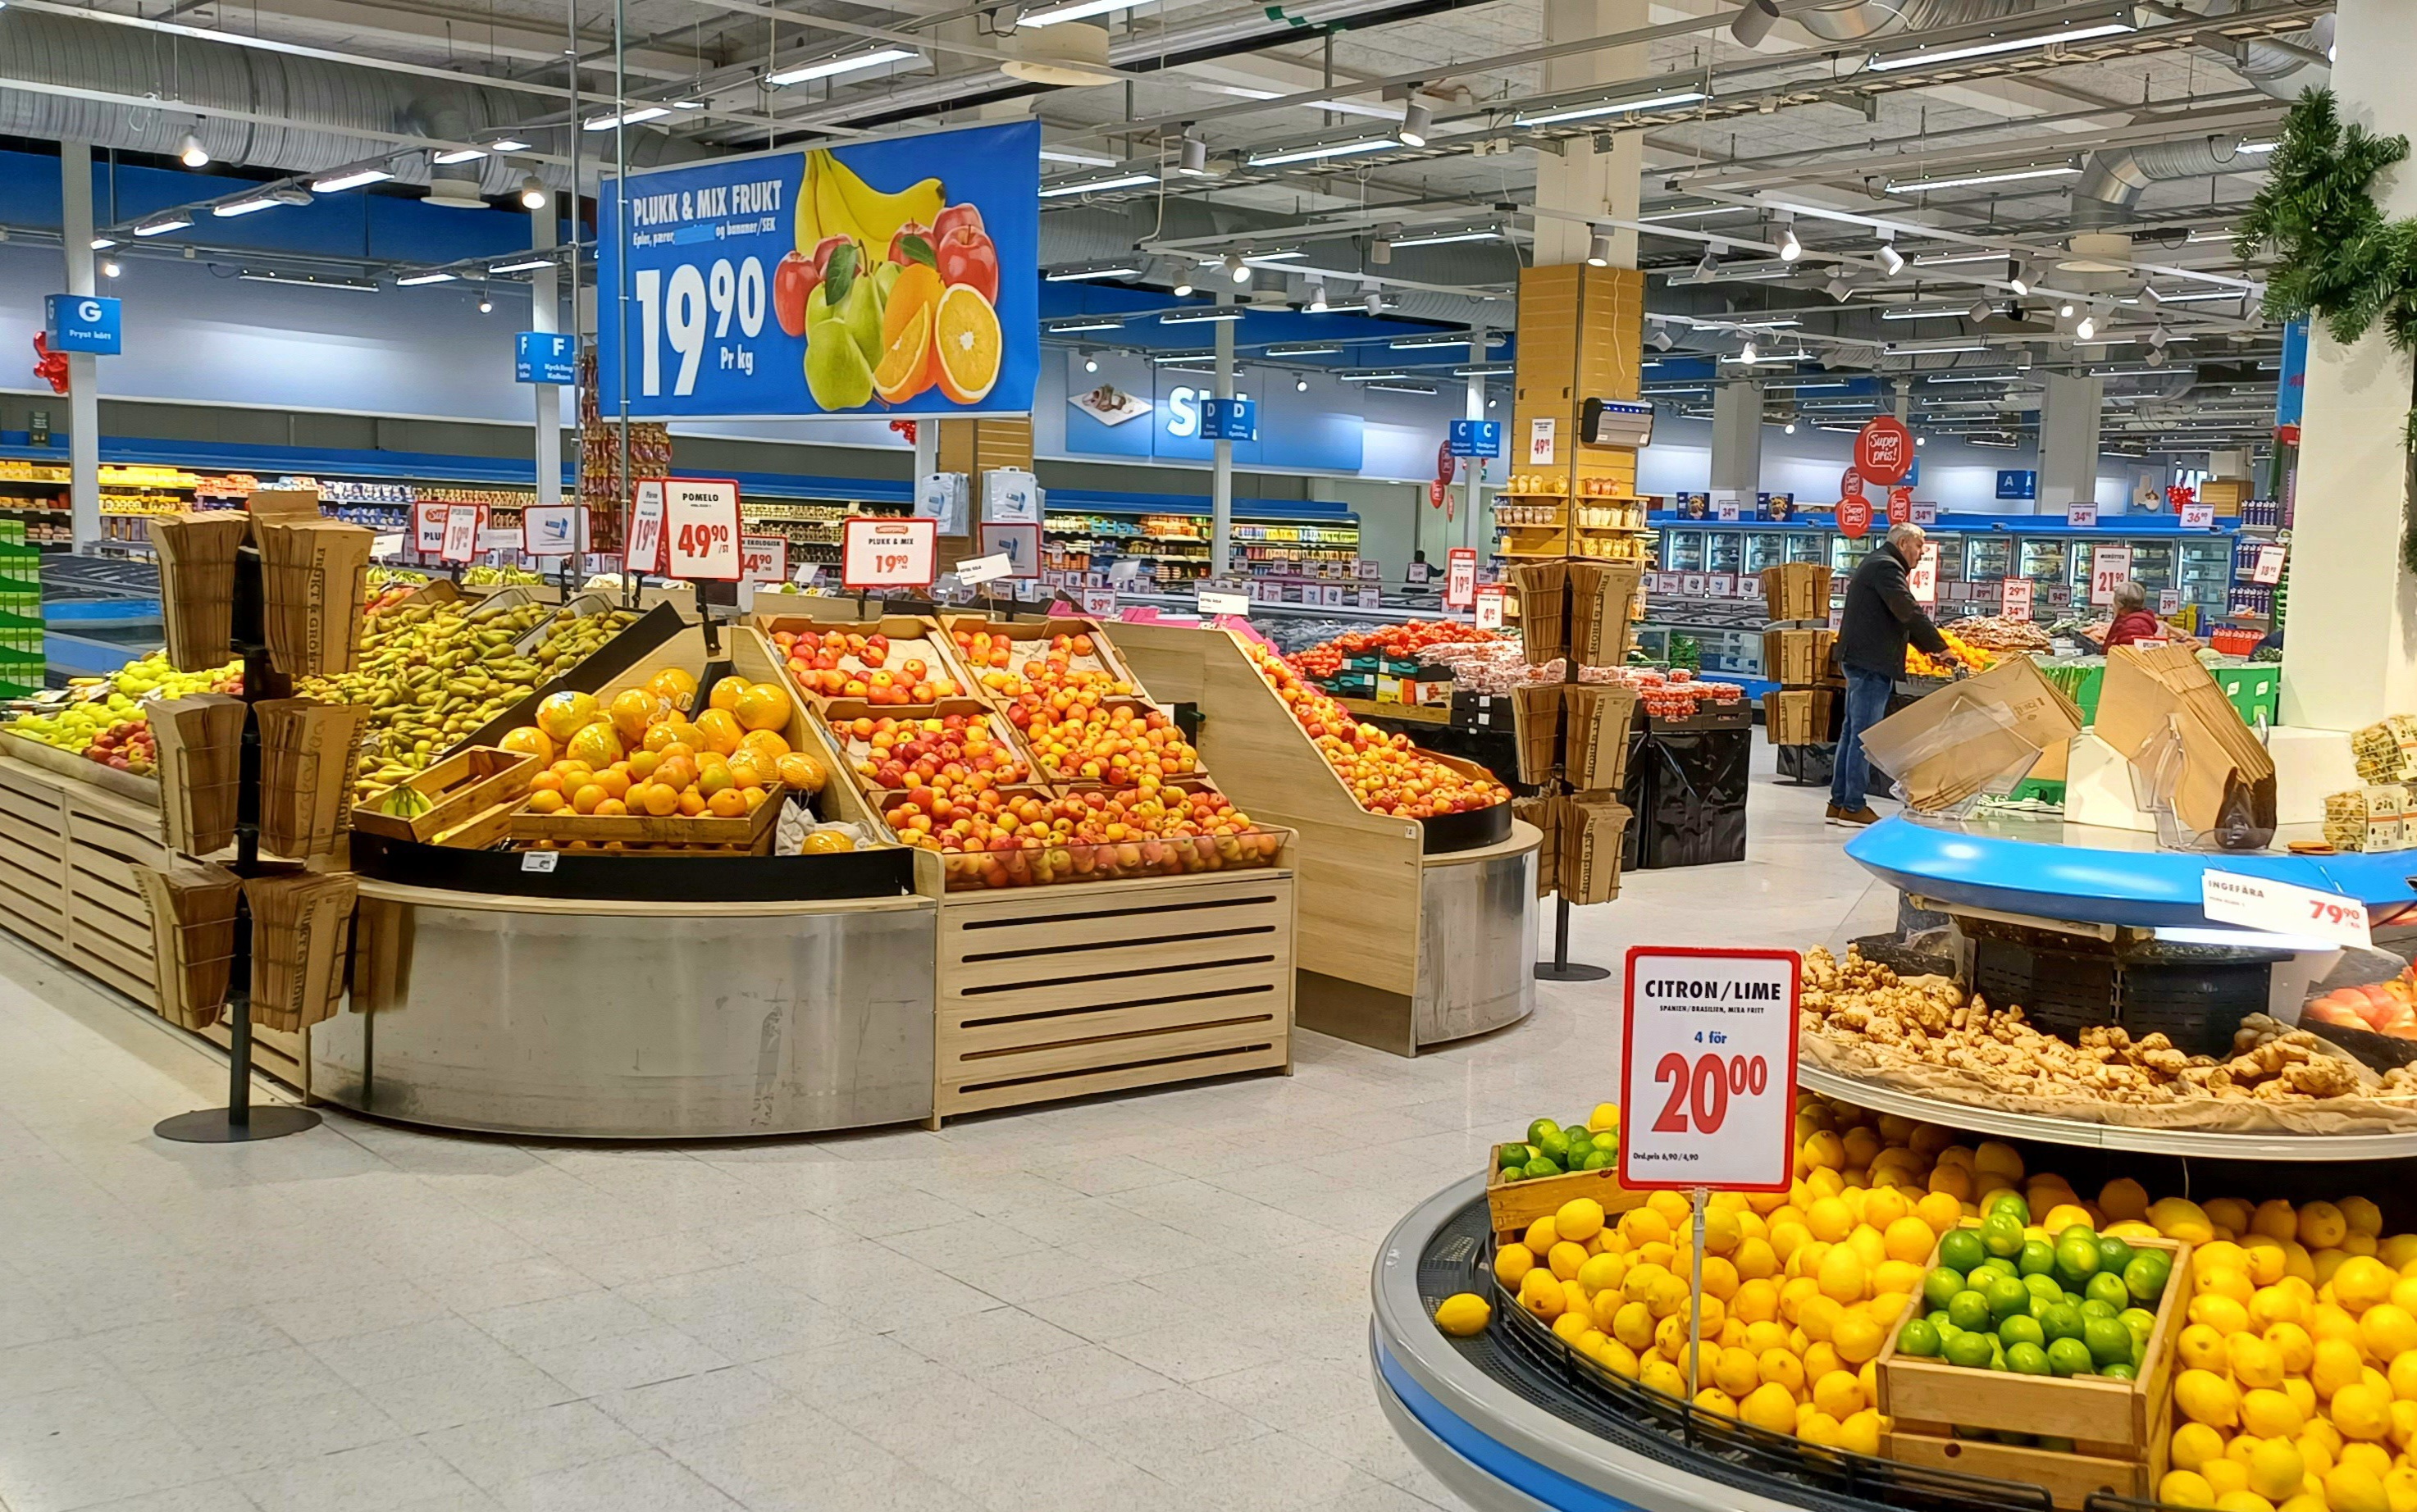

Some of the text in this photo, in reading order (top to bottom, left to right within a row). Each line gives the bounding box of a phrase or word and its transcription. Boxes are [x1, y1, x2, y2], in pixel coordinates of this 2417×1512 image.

[633, 180, 782, 227] PLUKK & MIX FRUKT
[716, 225, 725, 240] og
[79, 301, 102, 322] G
[553, 338, 564, 356] F
[720, 344, 754, 375] Pr kg
[1207, 403, 1215, 417] D
[1234, 403, 1244, 417] D
[1458, 422, 1466, 436] C
[1484, 423, 1492, 437] C
[1870, 434, 1898, 449] Super
[1872, 448, 1897, 464] pris!
[2004, 476, 2013, 486] A
[682, 493, 718, 502] POMELO
[310, 548, 326, 599] FRUKT
[308, 617, 320, 673] GRÖNT
[2208, 880, 2264, 898] INGEFÄRA
[1694, 1031, 1727, 1044] 4 för
